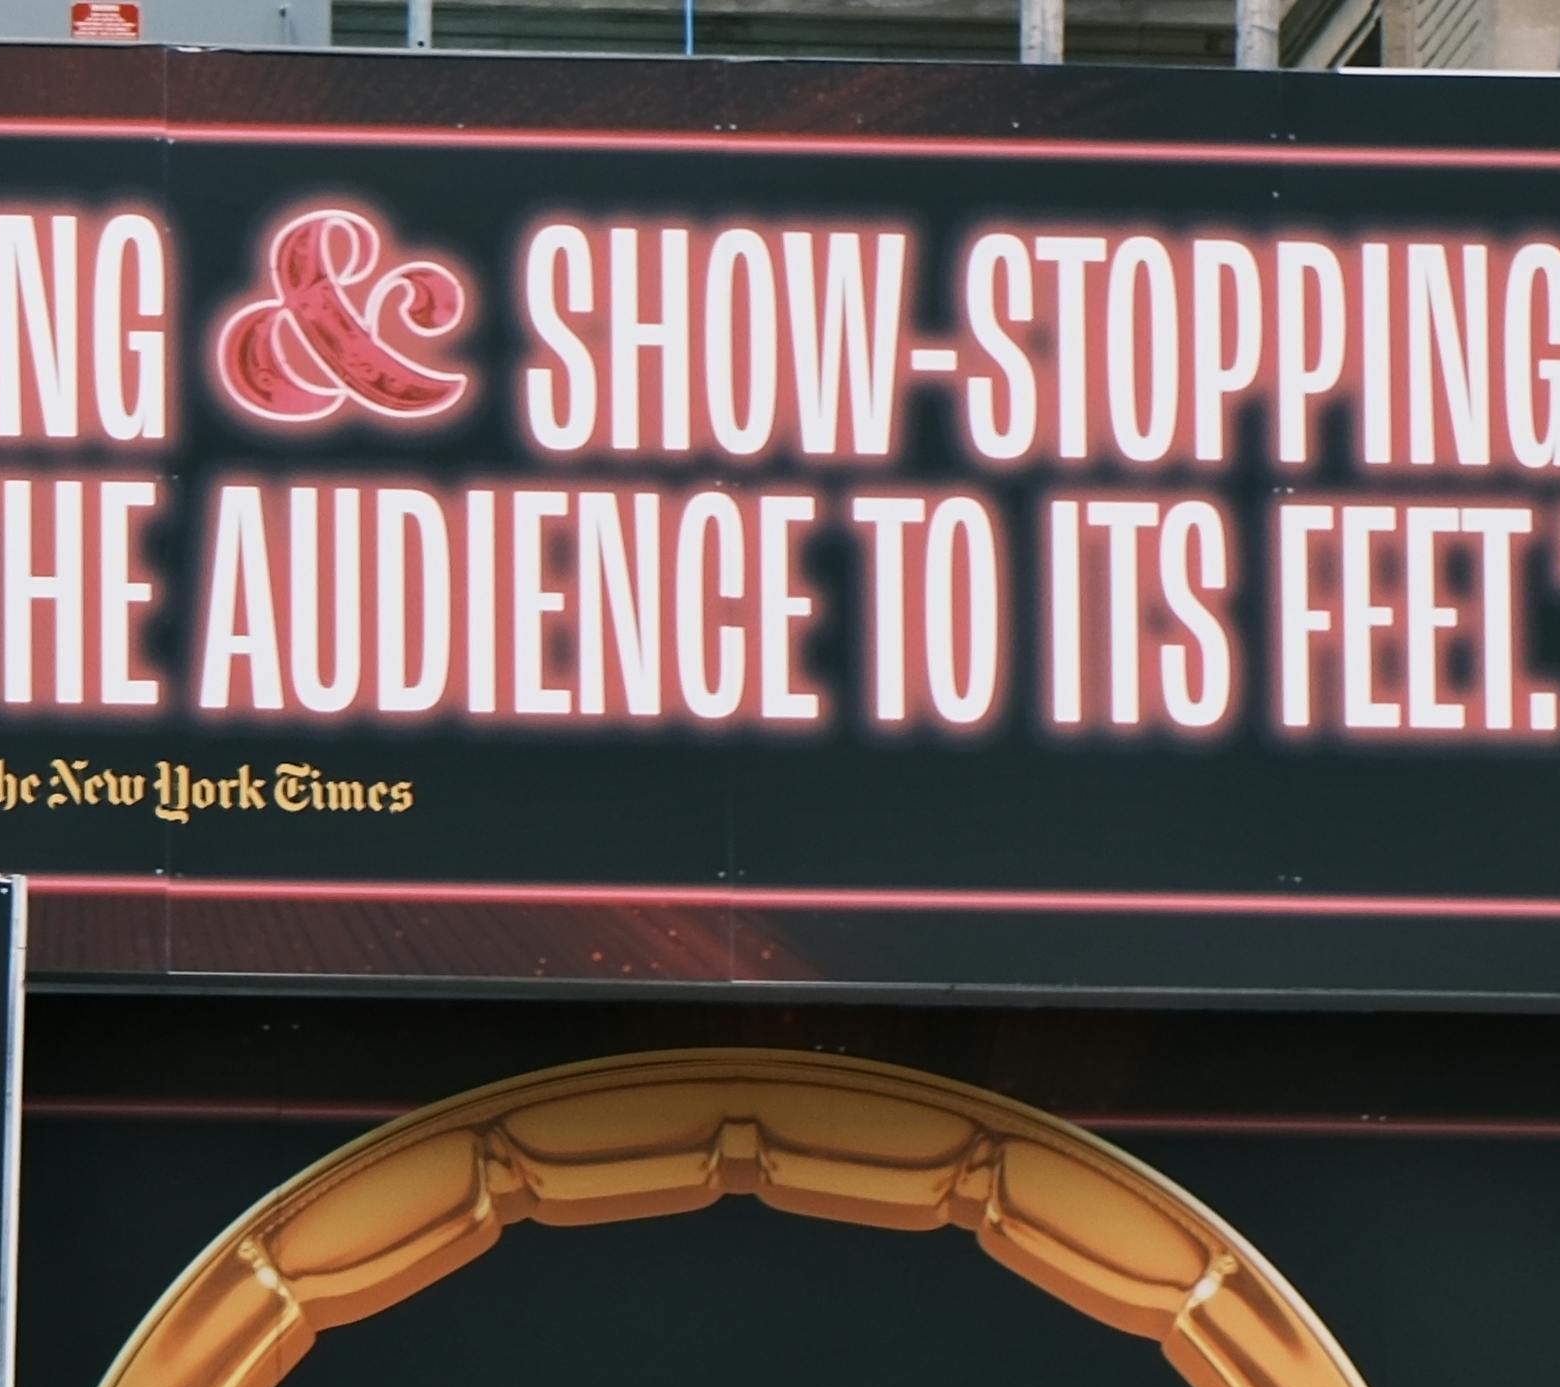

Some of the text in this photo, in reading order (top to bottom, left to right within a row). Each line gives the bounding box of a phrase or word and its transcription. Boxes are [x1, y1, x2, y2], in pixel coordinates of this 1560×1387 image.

[216, 208, 470, 422] &
[199, 484, 819, 719] AUDIENCE
[851, 495, 998, 724] TO
[1050, 499, 1231, 728] ITS
[47, 758, 147, 809] New
[154, 760, 268, 825] York
[273, 761, 415, 814] Times
